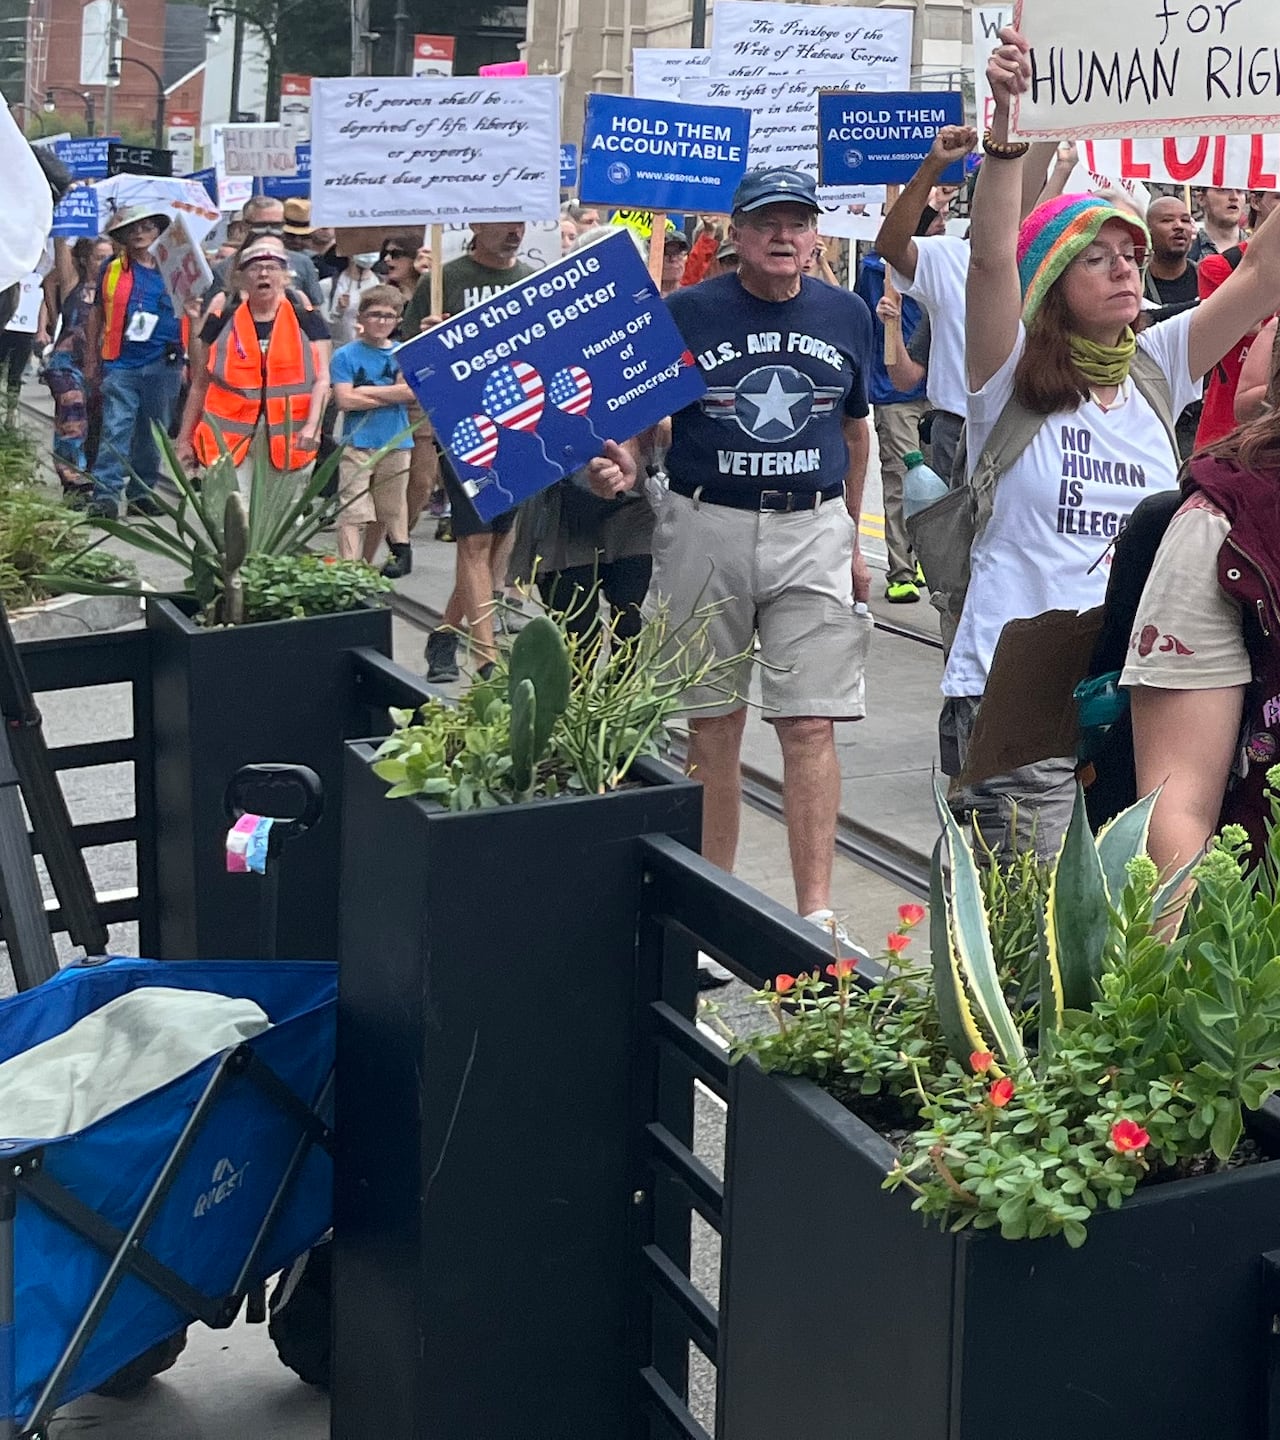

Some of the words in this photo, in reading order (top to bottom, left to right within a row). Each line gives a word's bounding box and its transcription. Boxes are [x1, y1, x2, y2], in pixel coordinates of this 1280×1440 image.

[750, 19, 774, 34] The
[780, 19, 839, 42] Privilege
[845, 28, 862, 43] of
[863, 28, 883, 40] the
[733, 41, 770, 57] Writ
[774, 46, 795, 61] of
[796, 43, 845, 60] Habeas
[850, 48, 899, 66] Corpus
[728, 66, 766, 77] shall
[1030, 47, 1180, 106] HUMAN
[344, 88, 378, 109] No
[373, 96, 431, 112] person
[438, 90, 480, 106] shall
[707, 83, 730, 98] The
[735, 83, 766, 101] right
[771, 82, 791, 99] of
[789, 81, 807, 94] the
[339, 118, 409, 139] deprived
[416, 119, 436, 138] of
[612, 116, 669, 137] HOLD
[674, 122, 731, 142] THEM
[842, 110, 891, 125] HOLD
[895, 110, 946, 123] THEM
[828, 125, 940, 141] ACCOUNTAB
[115, 148, 152, 167] ICE
[388, 148, 402, 159] or
[592, 134, 741, 162] ACCOUNTABLE
[324, 172, 386, 186] without
[392, 170, 420, 185] due
[421, 172, 487, 189] process
[493, 168, 510, 187] of
[438, 322, 479, 350] We
[480, 300, 522, 329] the
[521, 257, 601, 308] People
[449, 319, 547, 382] Deserve
[547, 280, 617, 331] Better
[582, 329, 626, 360] Hands
[626, 311, 653, 335] OFF
[619, 344, 635, 361] of
[698, 341, 742, 371] U.S.
[747, 331, 782, 355] AIR
[787, 331, 845, 371] FORCE
[623, 359, 647, 380] Our
[606, 363, 681, 411] Democracy
[1061, 425, 1091, 455] NO
[716, 447, 821, 477] VETERAN
[1061, 452, 1146, 488] HUMAN
[1058, 479, 1084, 507] IS
[1057, 508, 1132, 538] ILLEG
